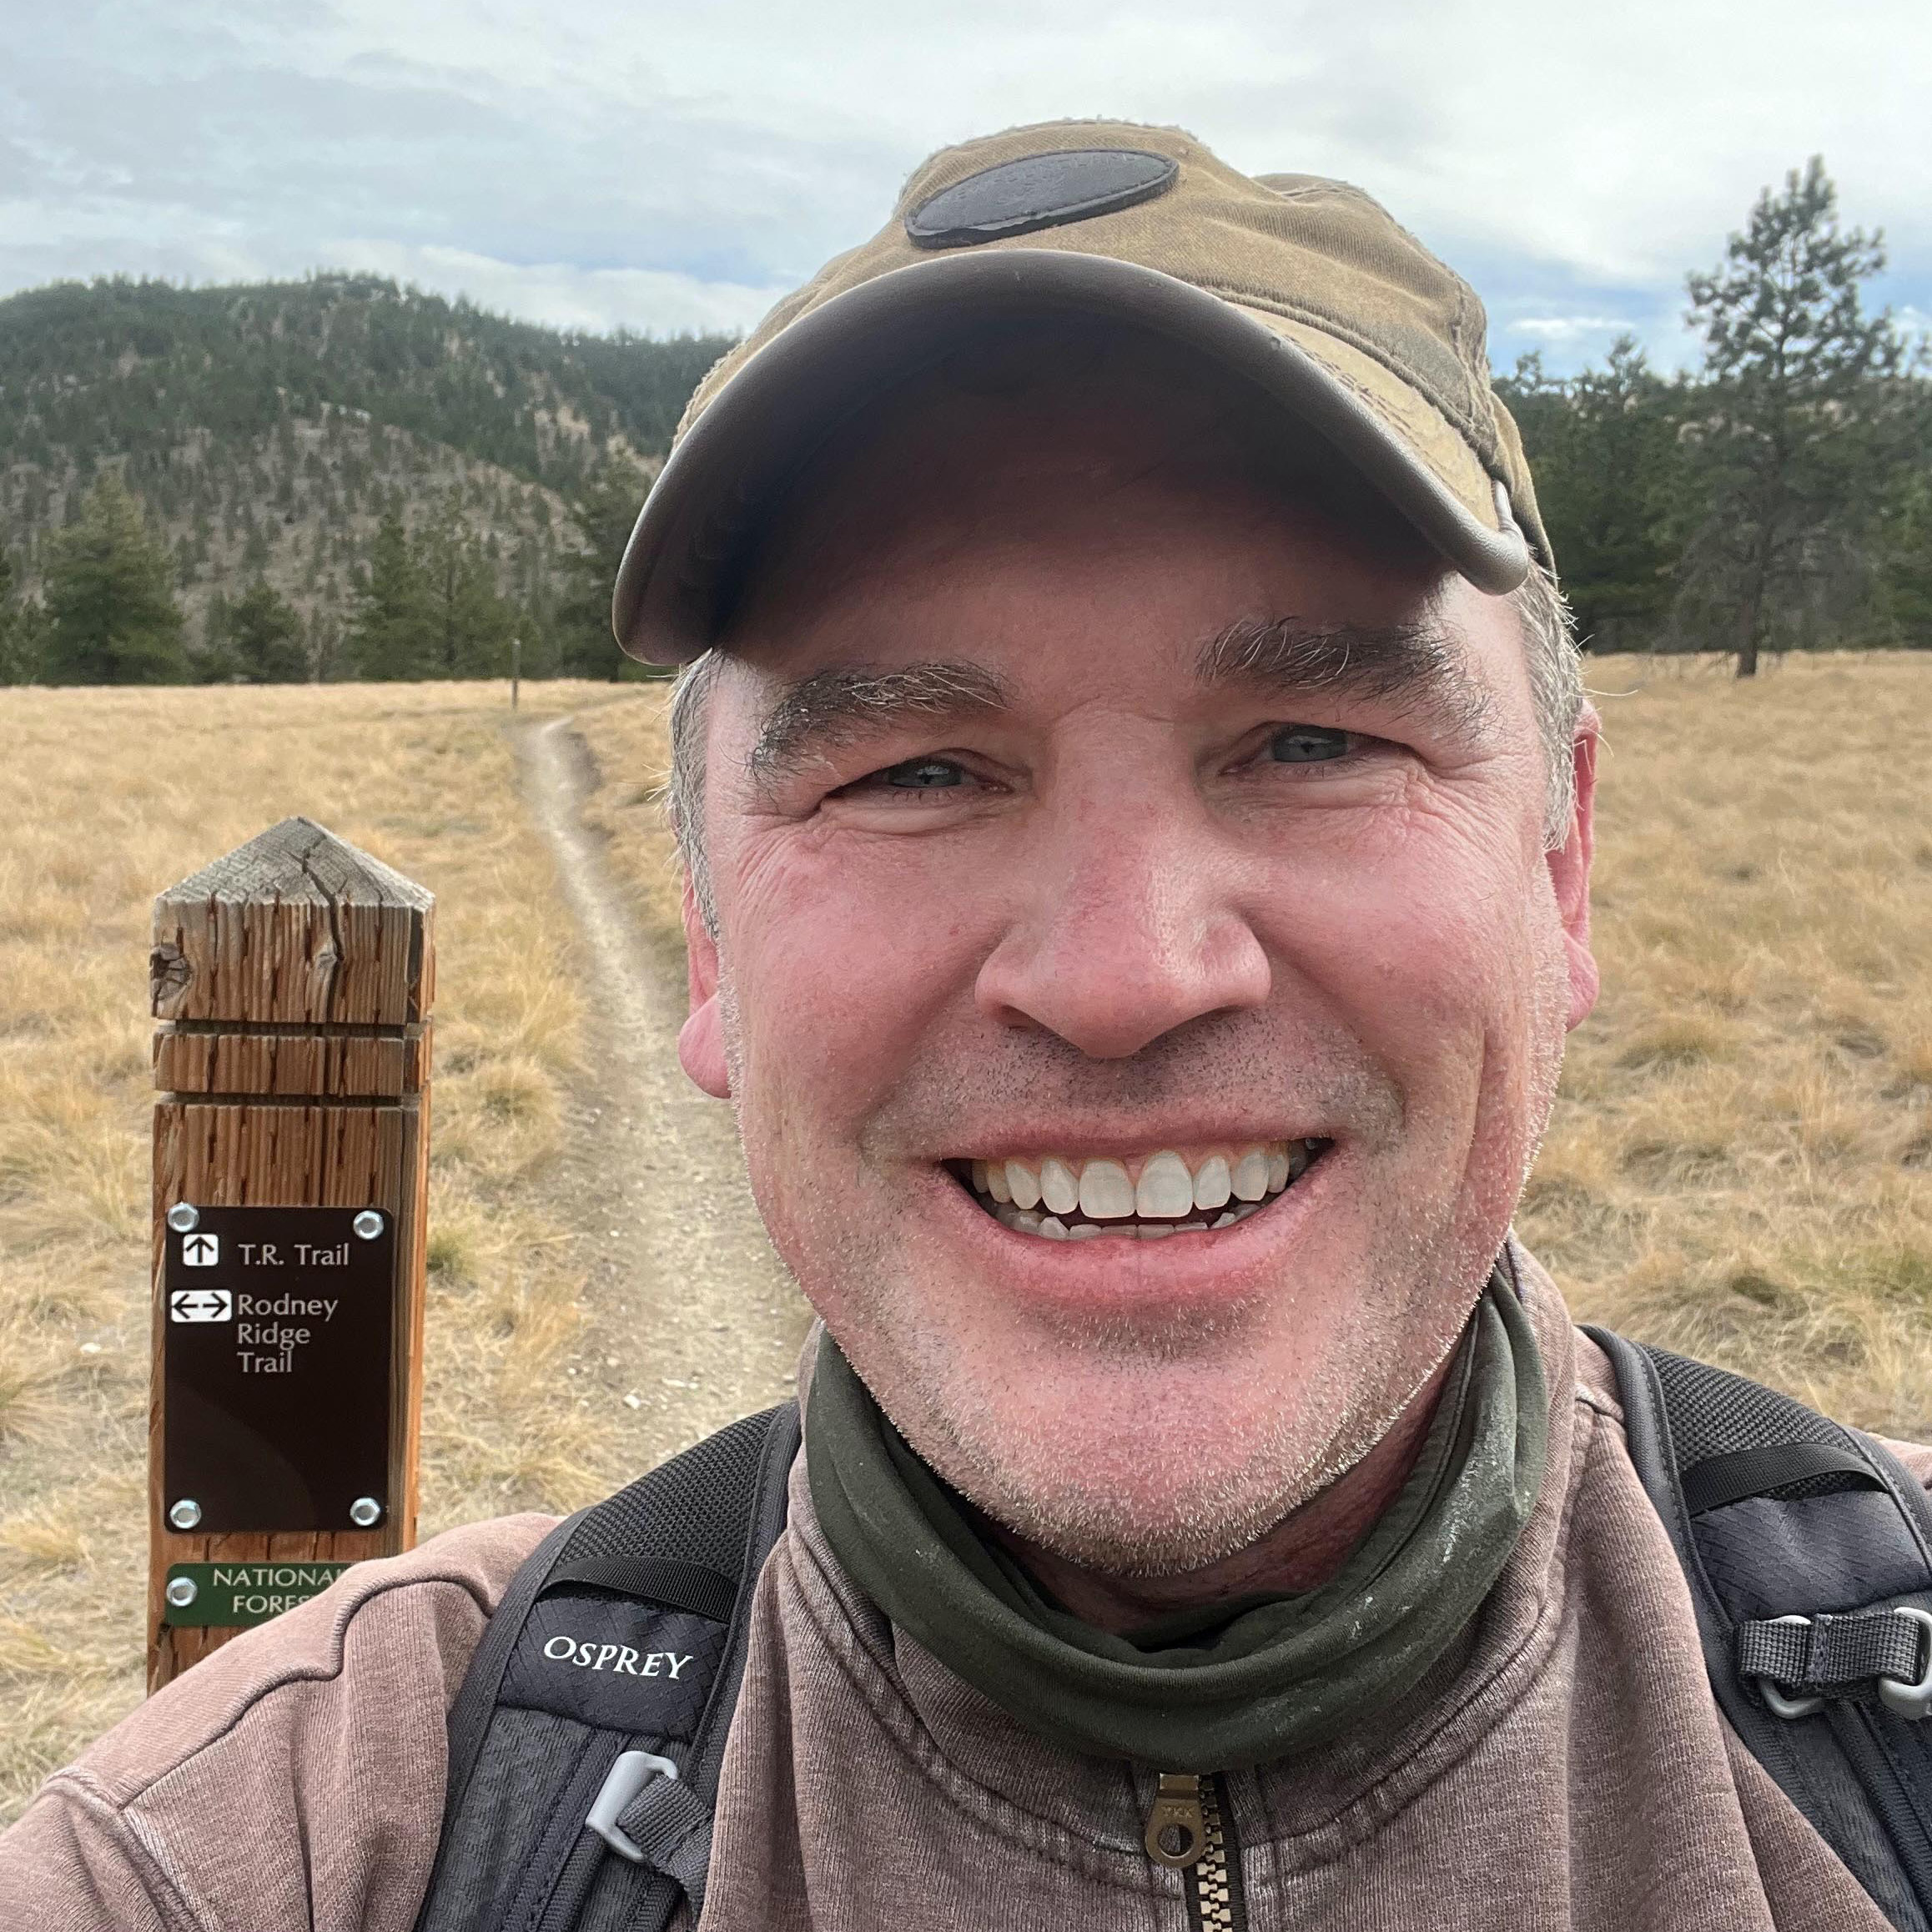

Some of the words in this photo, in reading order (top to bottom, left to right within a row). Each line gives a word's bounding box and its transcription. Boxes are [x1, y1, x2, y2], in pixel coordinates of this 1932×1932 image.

[237, 1244, 284, 1266] T.R.
[294, 1243, 350, 1266] Trail
[238, 1293, 339, 1322] Rodney
[237, 1321, 311, 1351] Ridge
[237, 1351, 293, 1374] Trail
[543, 1635, 694, 1680] OSPREY
